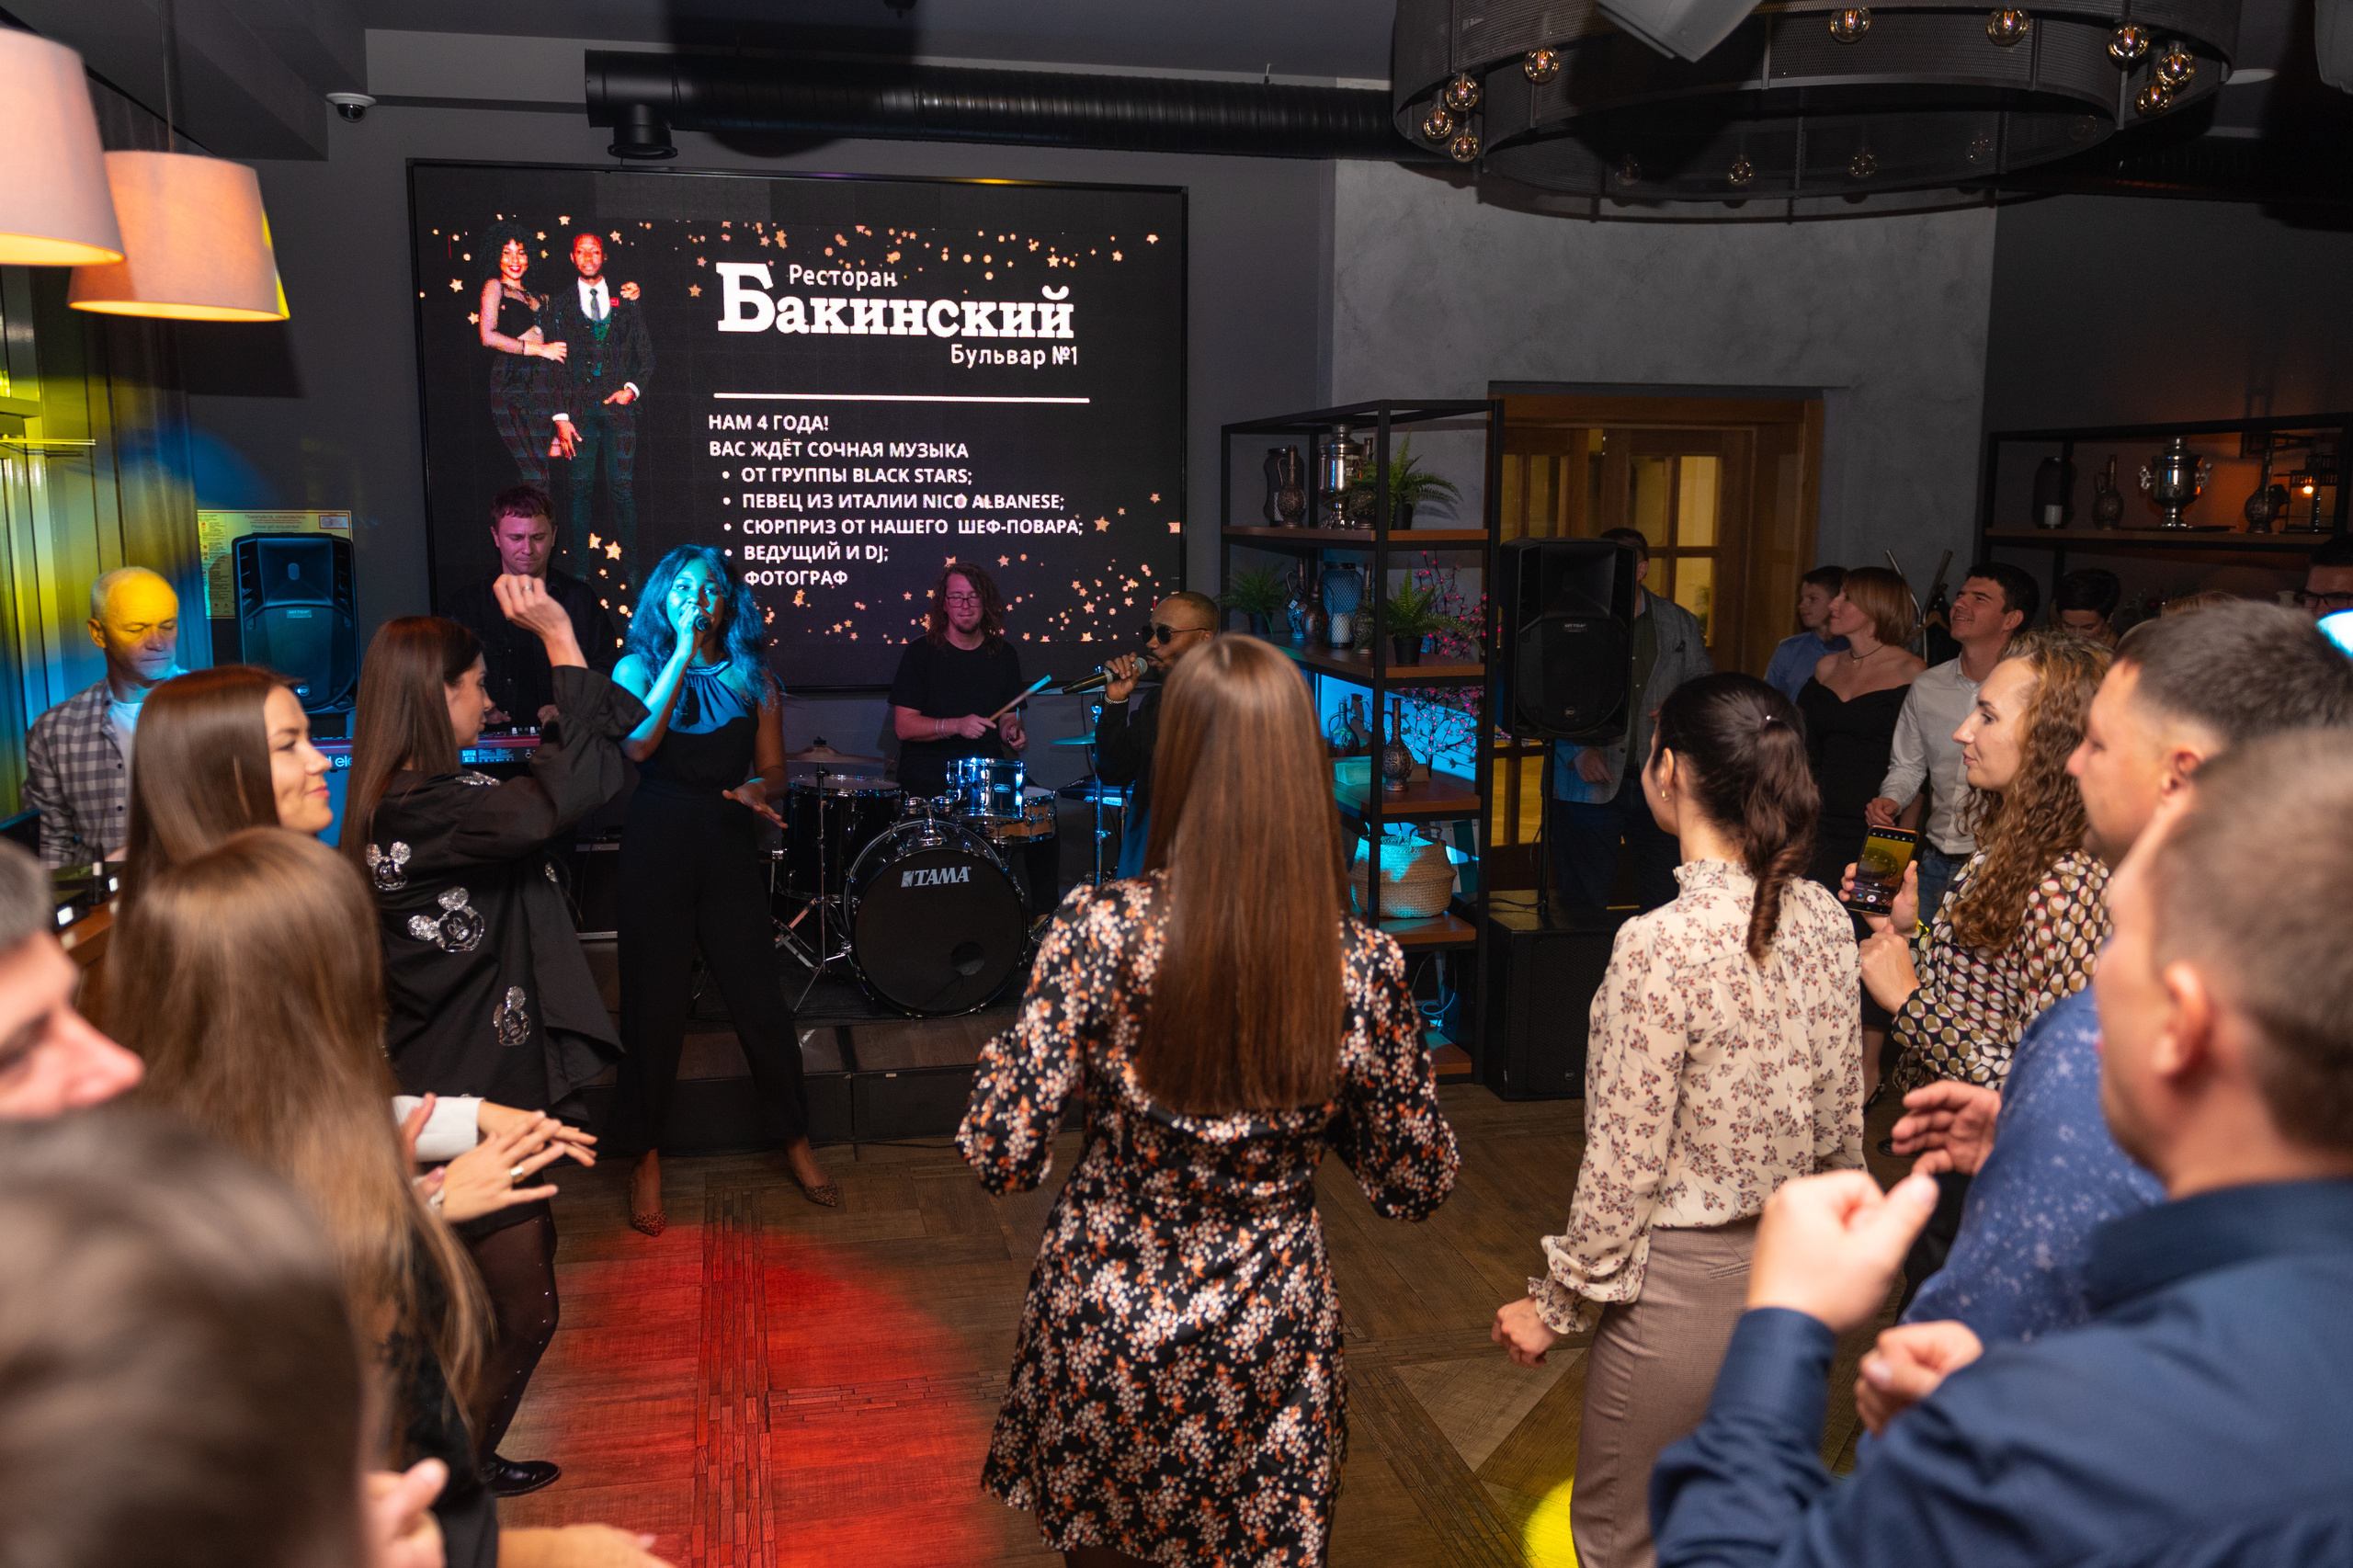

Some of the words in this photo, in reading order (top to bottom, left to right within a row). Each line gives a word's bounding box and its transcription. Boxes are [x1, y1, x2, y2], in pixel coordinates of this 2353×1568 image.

[789, 264, 898, 291] Ресторан
[715, 262, 1074, 338] Бакинский
[950, 344, 1046, 369] Бульвар
[1051, 346, 1077, 365] №1
[708, 414, 752, 430] НАМ
[756, 415, 768, 431] 4
[773, 415, 829, 434] ГОДА!
[709, 440, 746, 457] ВАС
[750, 437, 803, 460] ЖДЁТ
[807, 441, 884, 458] СОЧНАЯ
[889, 442, 969, 459] МУЗЫКА
[741, 467, 767, 483] ОТ
[771, 467, 847, 483] ГРУППЫ
[852, 468, 910, 483] BLACK
[914, 468, 972, 485] STARS;
[743, 493, 803, 513] ПЕВЕЦ
[807, 494, 834, 509] ИЗ
[838, 494, 917, 509] ИТАЛИИ
[922, 494, 968, 509] NICO
[972, 494, 1065, 511] ALBANESE;
[743, 518, 836, 535] СЮРПРИЗ
[841, 518, 866, 535] ОТ
[870, 518, 949, 535] НАШЕГО
[958, 517, 1084, 536] ШЕФ-ПОВАРА;
[744, 541, 841, 564] ВЕДУЩИЙ
[846, 545, 860, 560] И
[865, 544, 889, 563] DJ;
[744, 570, 848, 586] ФОТОГРАФ
[914, 866, 970, 887] TAMA
